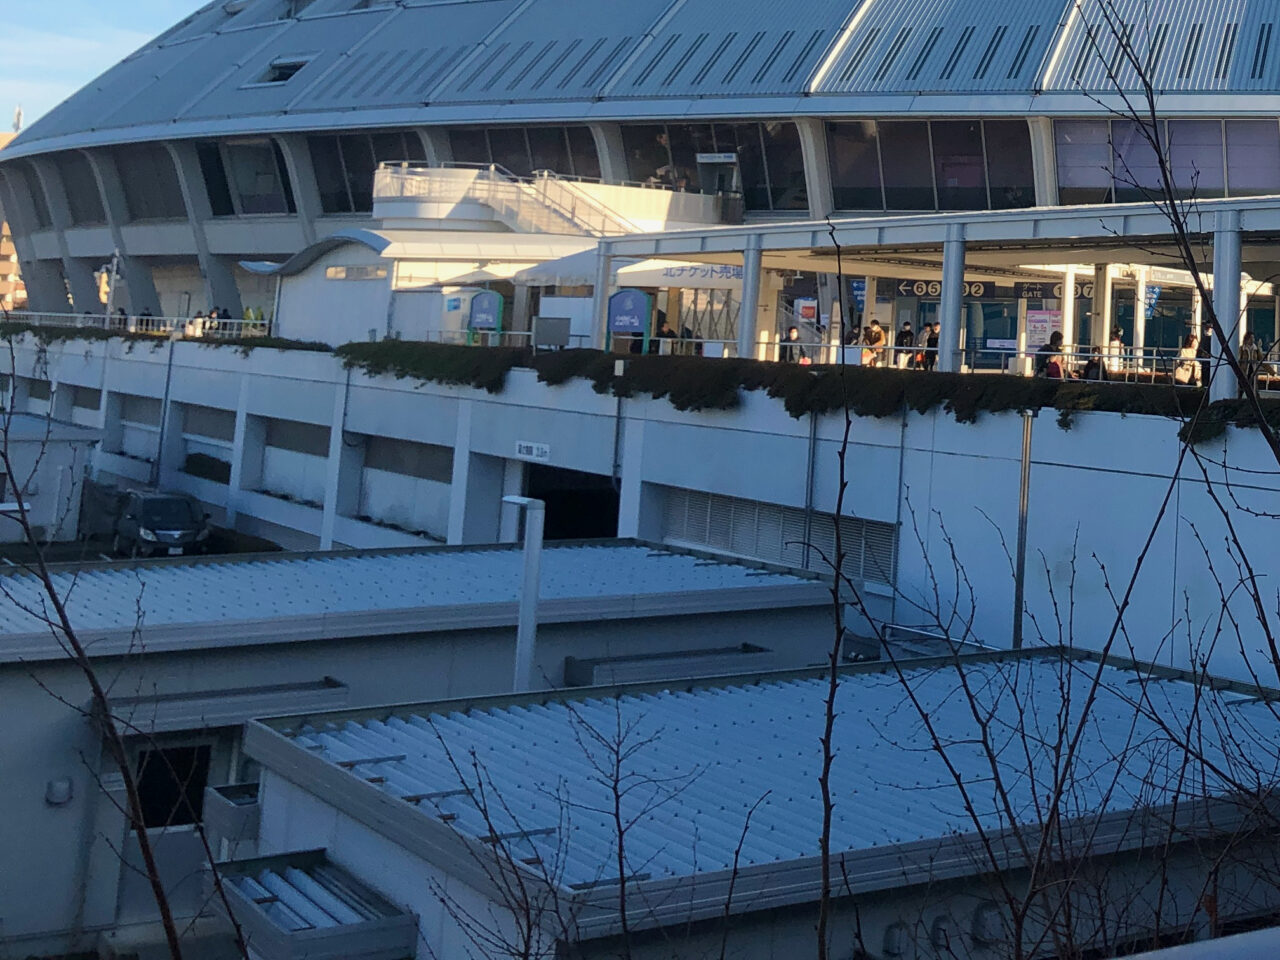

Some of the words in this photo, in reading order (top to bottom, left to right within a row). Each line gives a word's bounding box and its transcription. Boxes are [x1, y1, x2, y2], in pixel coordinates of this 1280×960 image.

[663, 265, 744, 279] 北チケット売場
[1021, 290, 1042, 298] GATE
